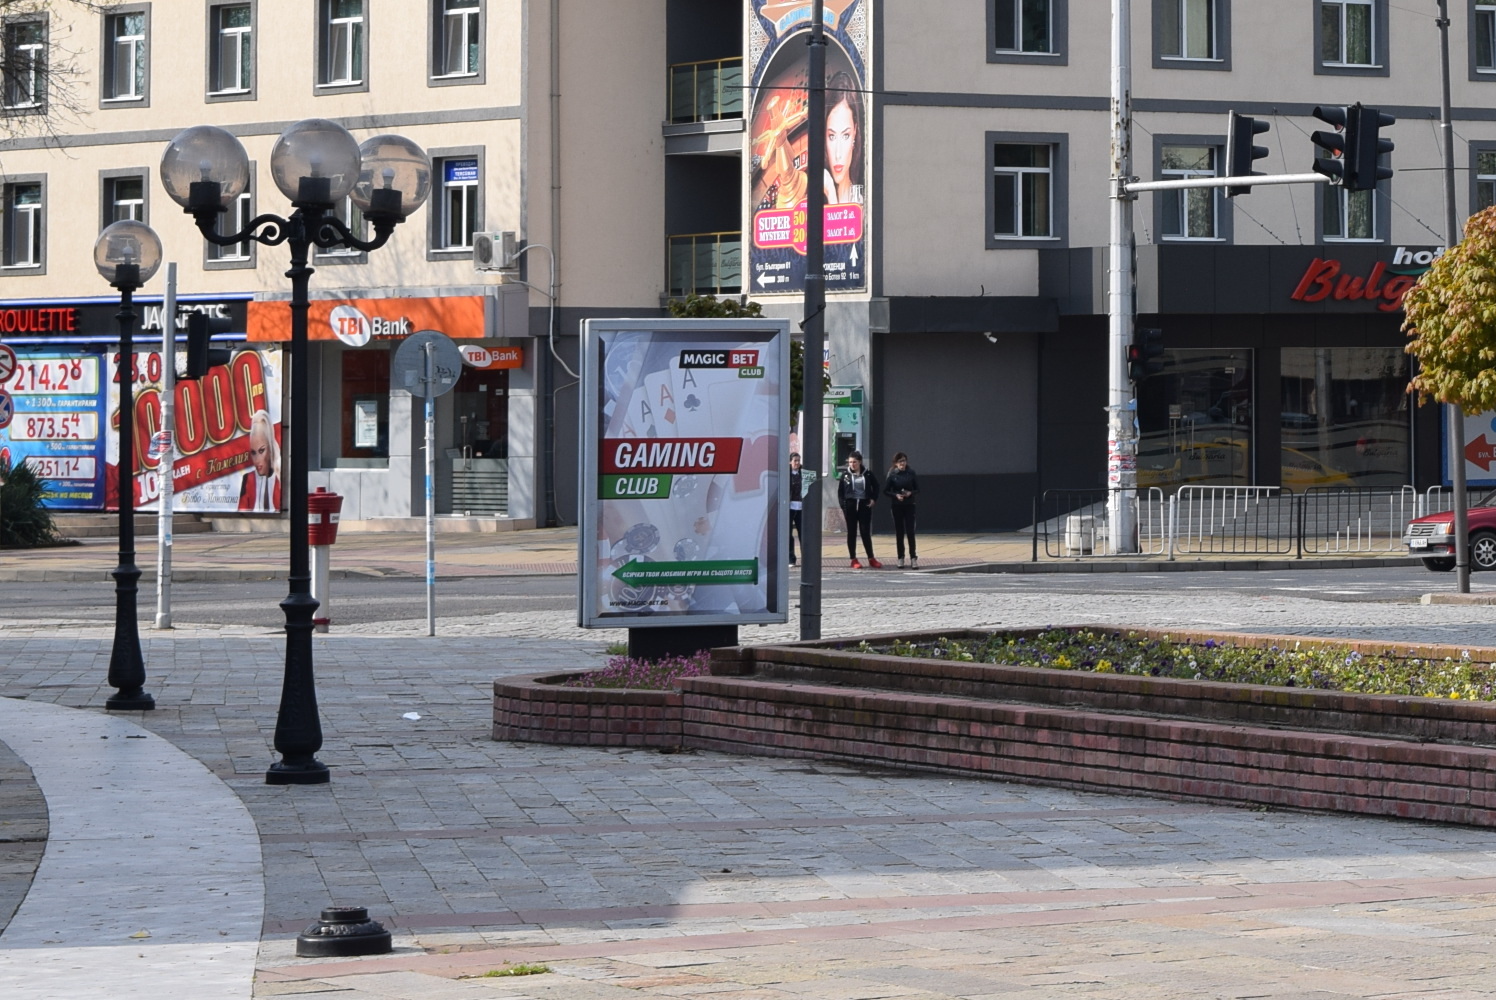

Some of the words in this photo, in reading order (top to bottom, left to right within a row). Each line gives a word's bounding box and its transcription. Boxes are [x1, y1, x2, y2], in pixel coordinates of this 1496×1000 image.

[759, 216, 791, 231] SUPER
[759, 230, 791, 242] MYSTERY
[1393, 247, 1446, 265] hot
[1291, 257, 1417, 312] Bulg
[338, 317, 364, 335] TBI
[372, 316, 409, 335] Bank
[467, 351, 487, 362] TBI
[492, 351, 518, 361] Bank
[684, 353, 726, 364] MAGIC
[732, 353, 755, 364] BET
[741, 368, 762, 376] CLUB
[206, 452, 250, 475] Камелия
[615, 442, 716, 468] GAMING
[615, 477, 659, 495] CLUB
